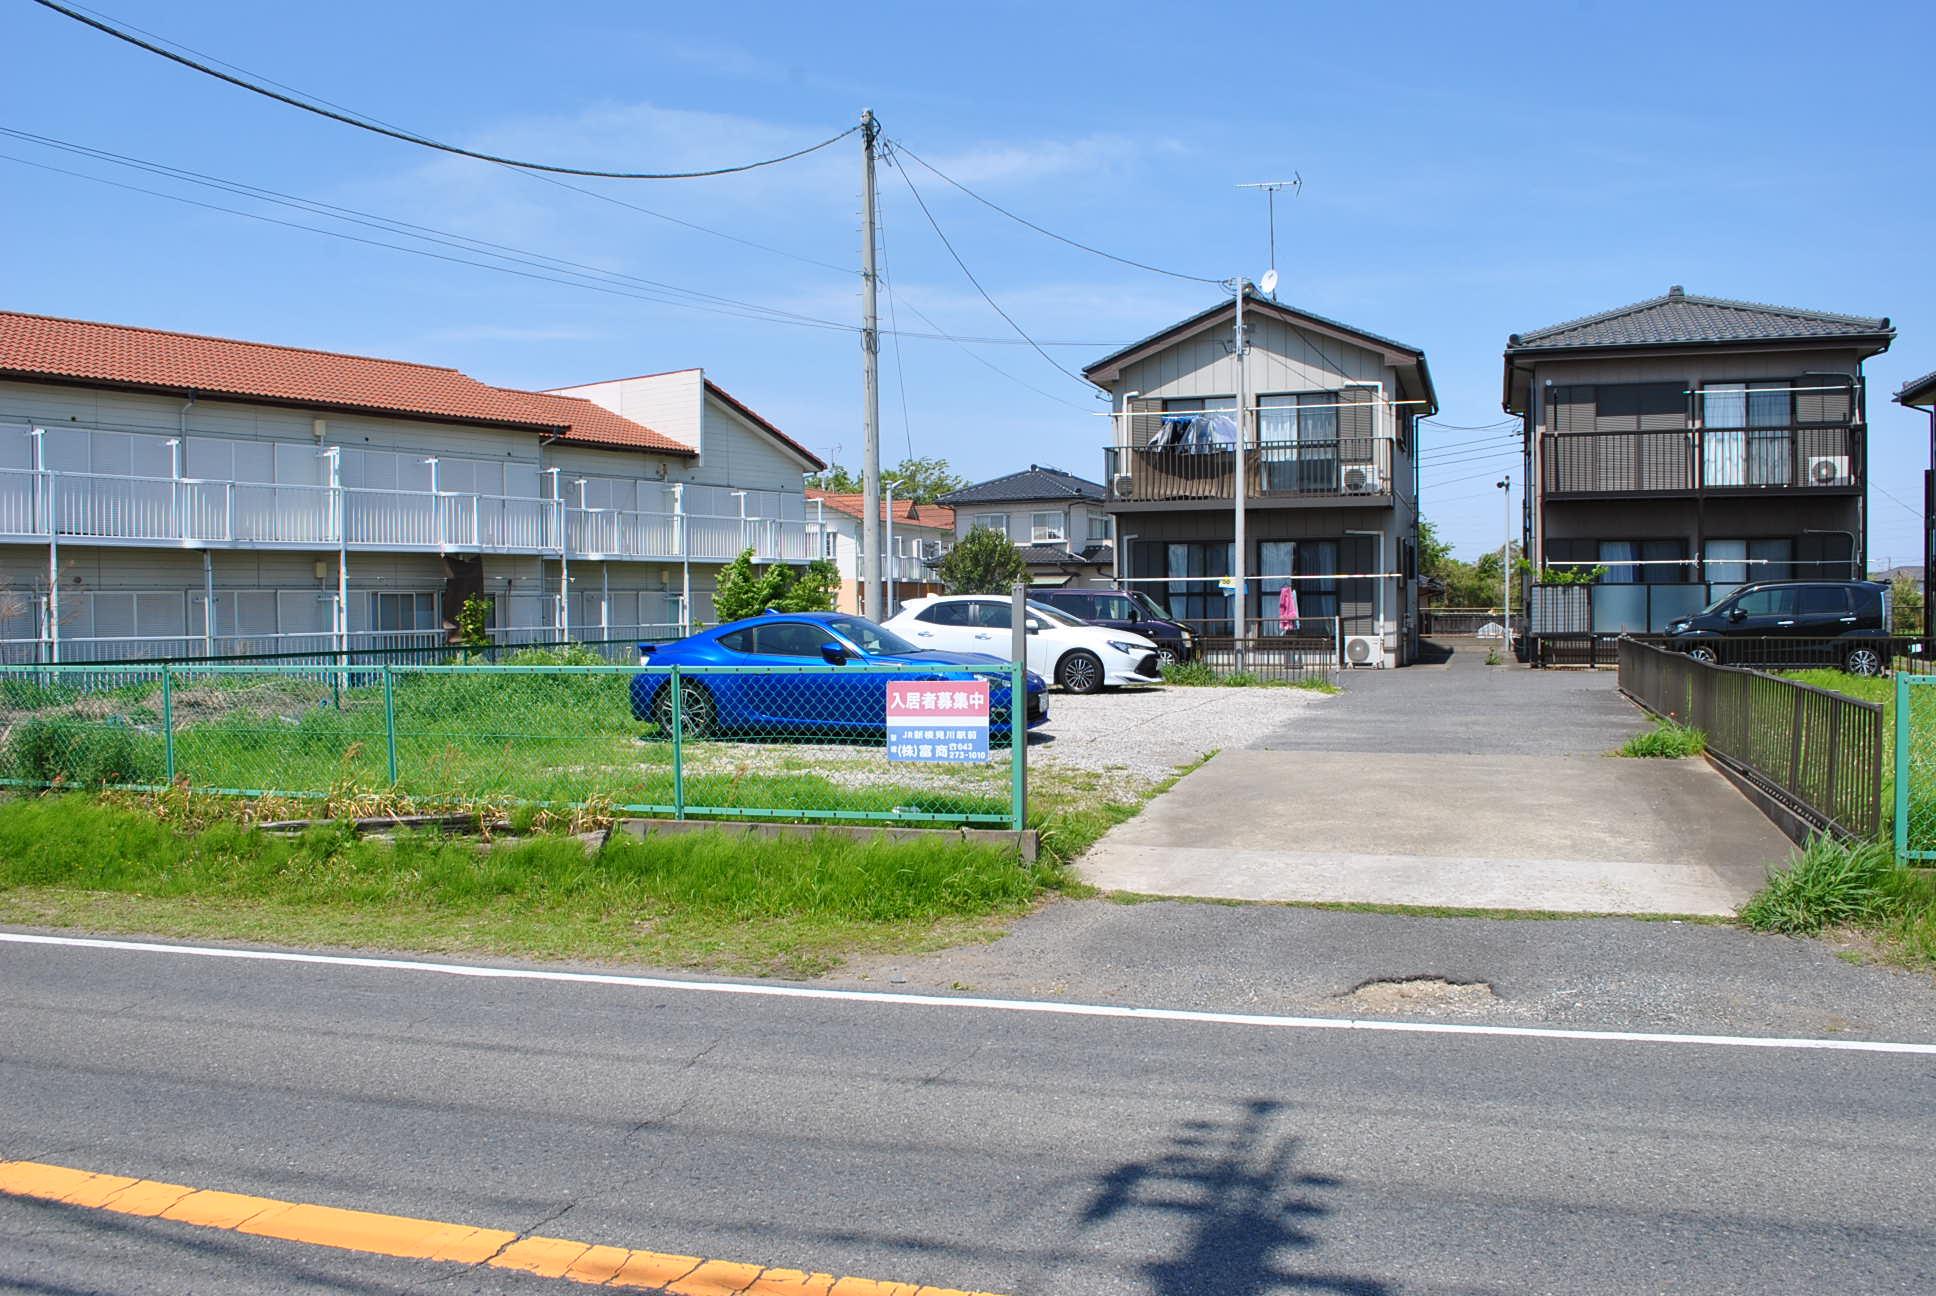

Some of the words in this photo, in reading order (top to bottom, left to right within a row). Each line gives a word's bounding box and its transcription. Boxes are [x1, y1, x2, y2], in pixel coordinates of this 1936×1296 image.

[890, 691, 984, 709] 入居者募集中
